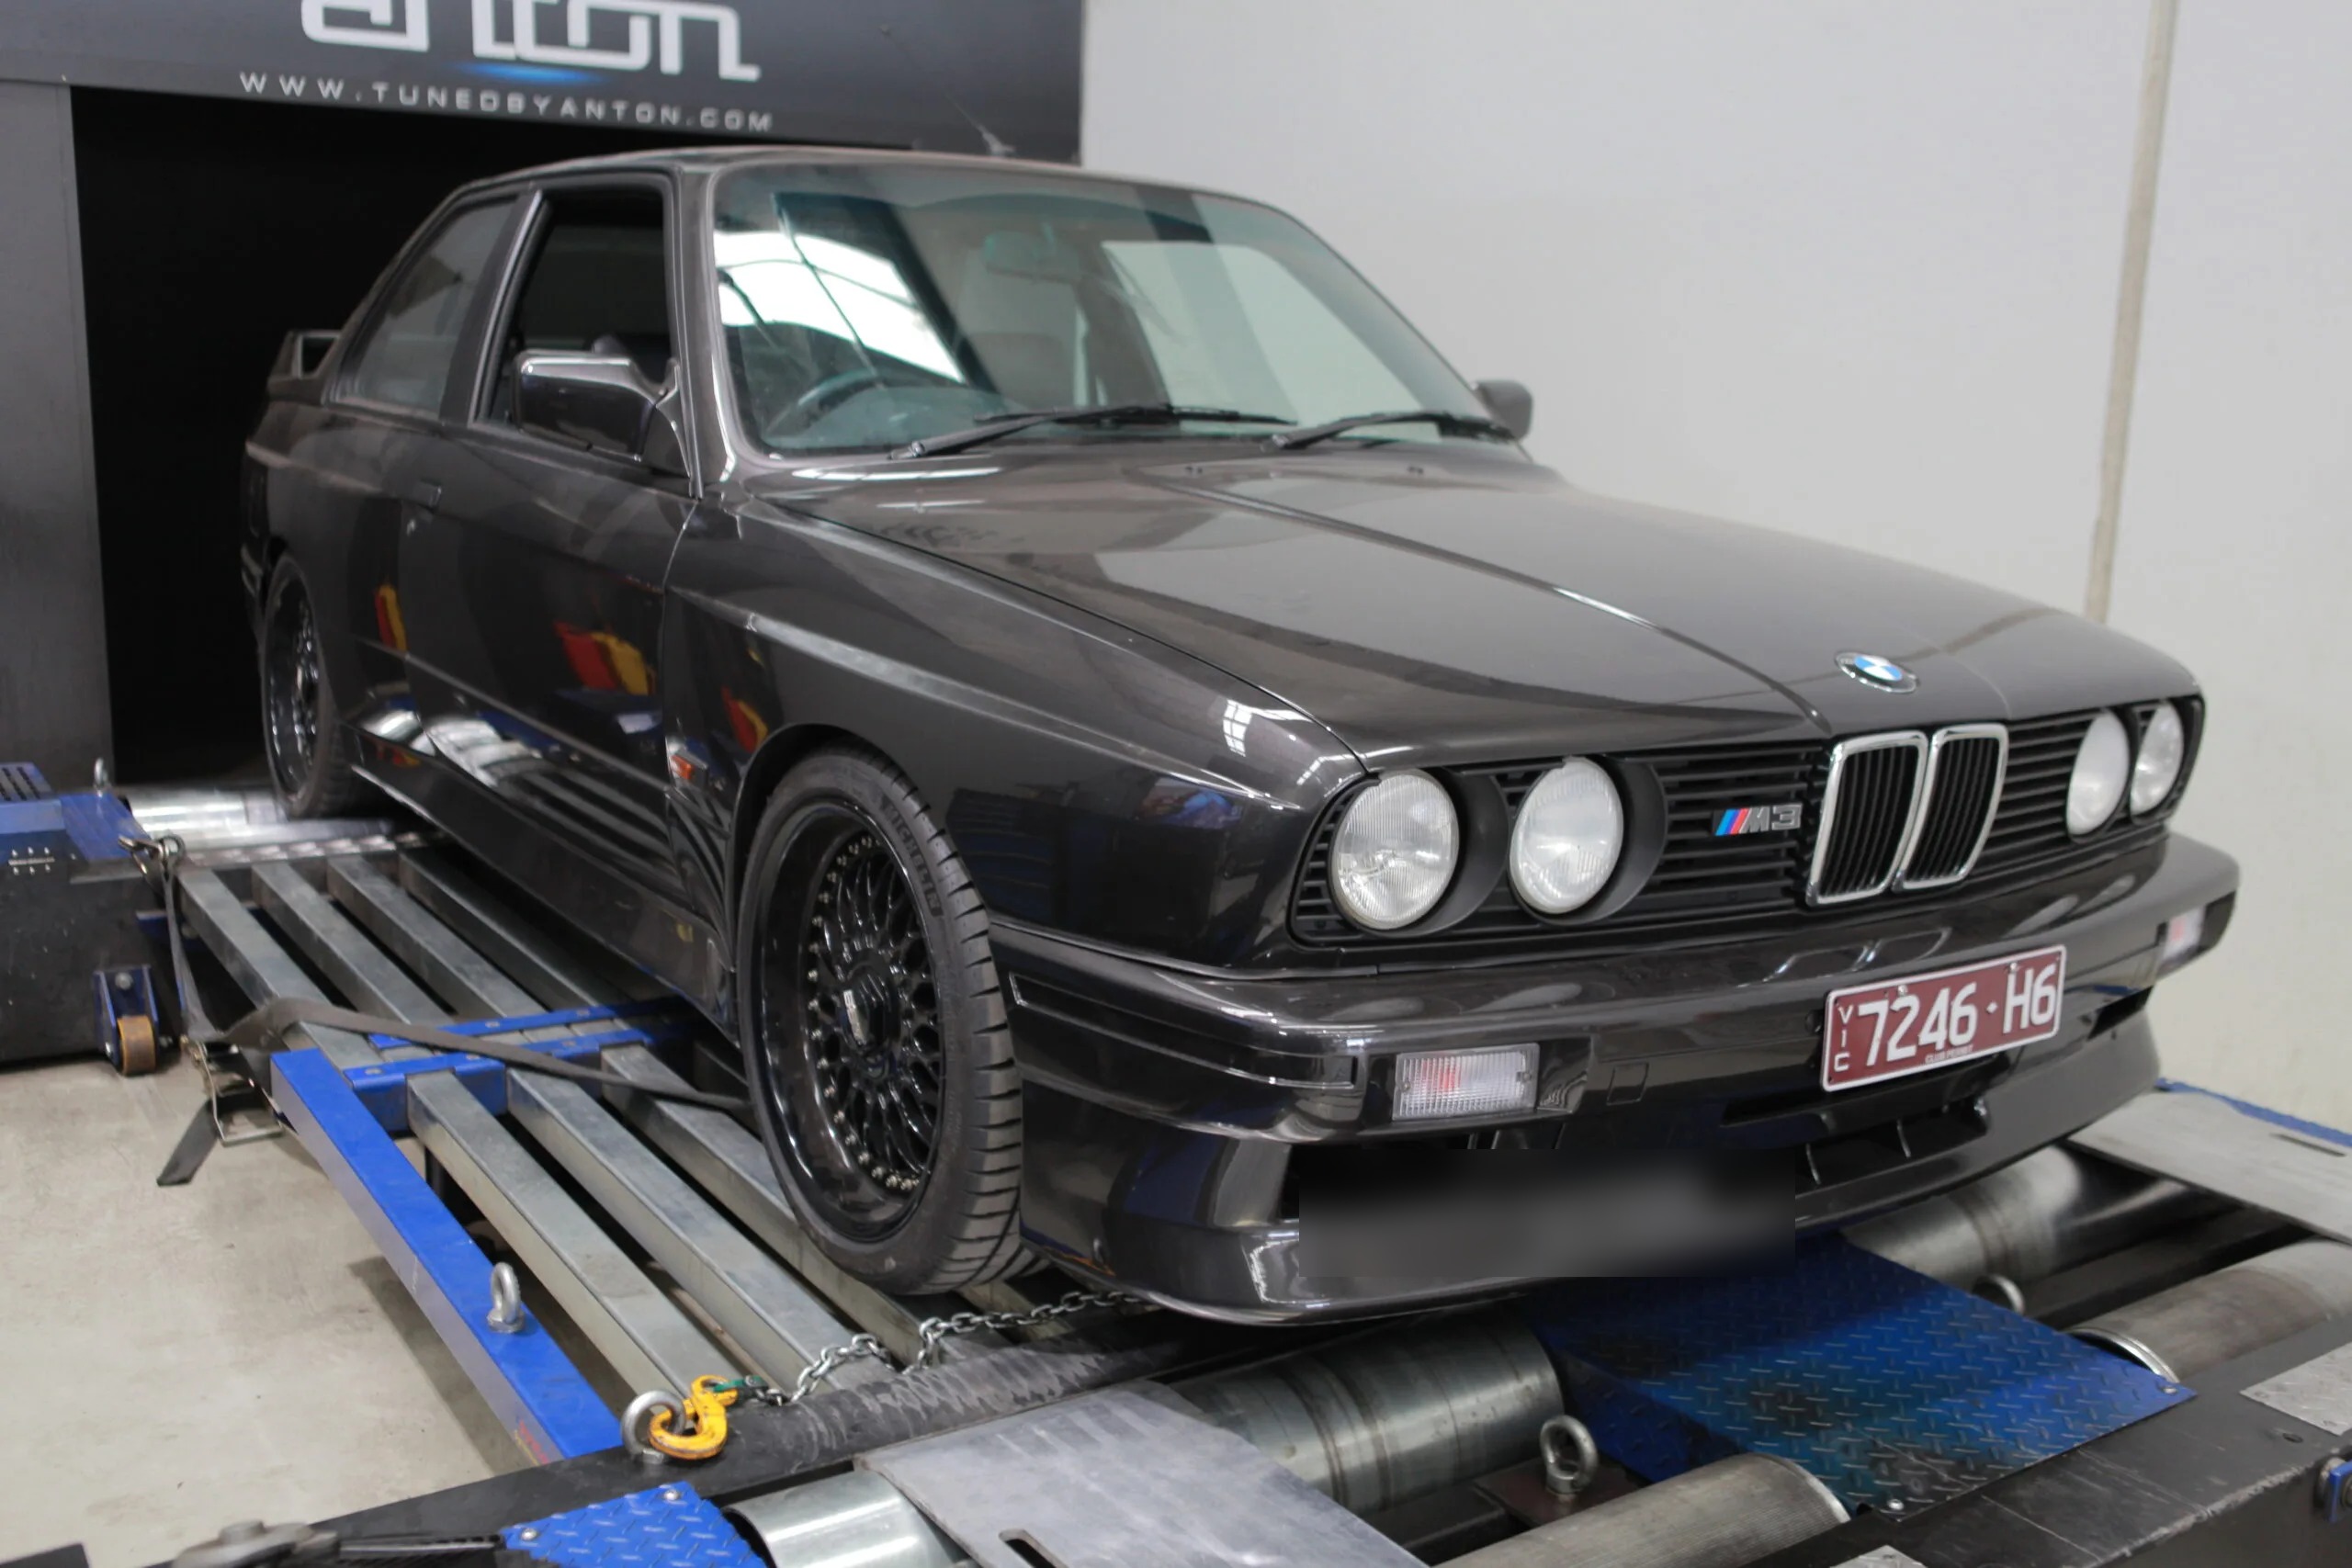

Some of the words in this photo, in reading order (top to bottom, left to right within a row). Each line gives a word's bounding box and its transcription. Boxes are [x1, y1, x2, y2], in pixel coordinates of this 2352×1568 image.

[240, 72, 773, 131] WWW.TUNEDBYANTON.COM
[1738, 803, 1803, 834] M3
[883, 800, 941, 910] MICHELIN
[1834, 1004, 1852, 1072] VIC
